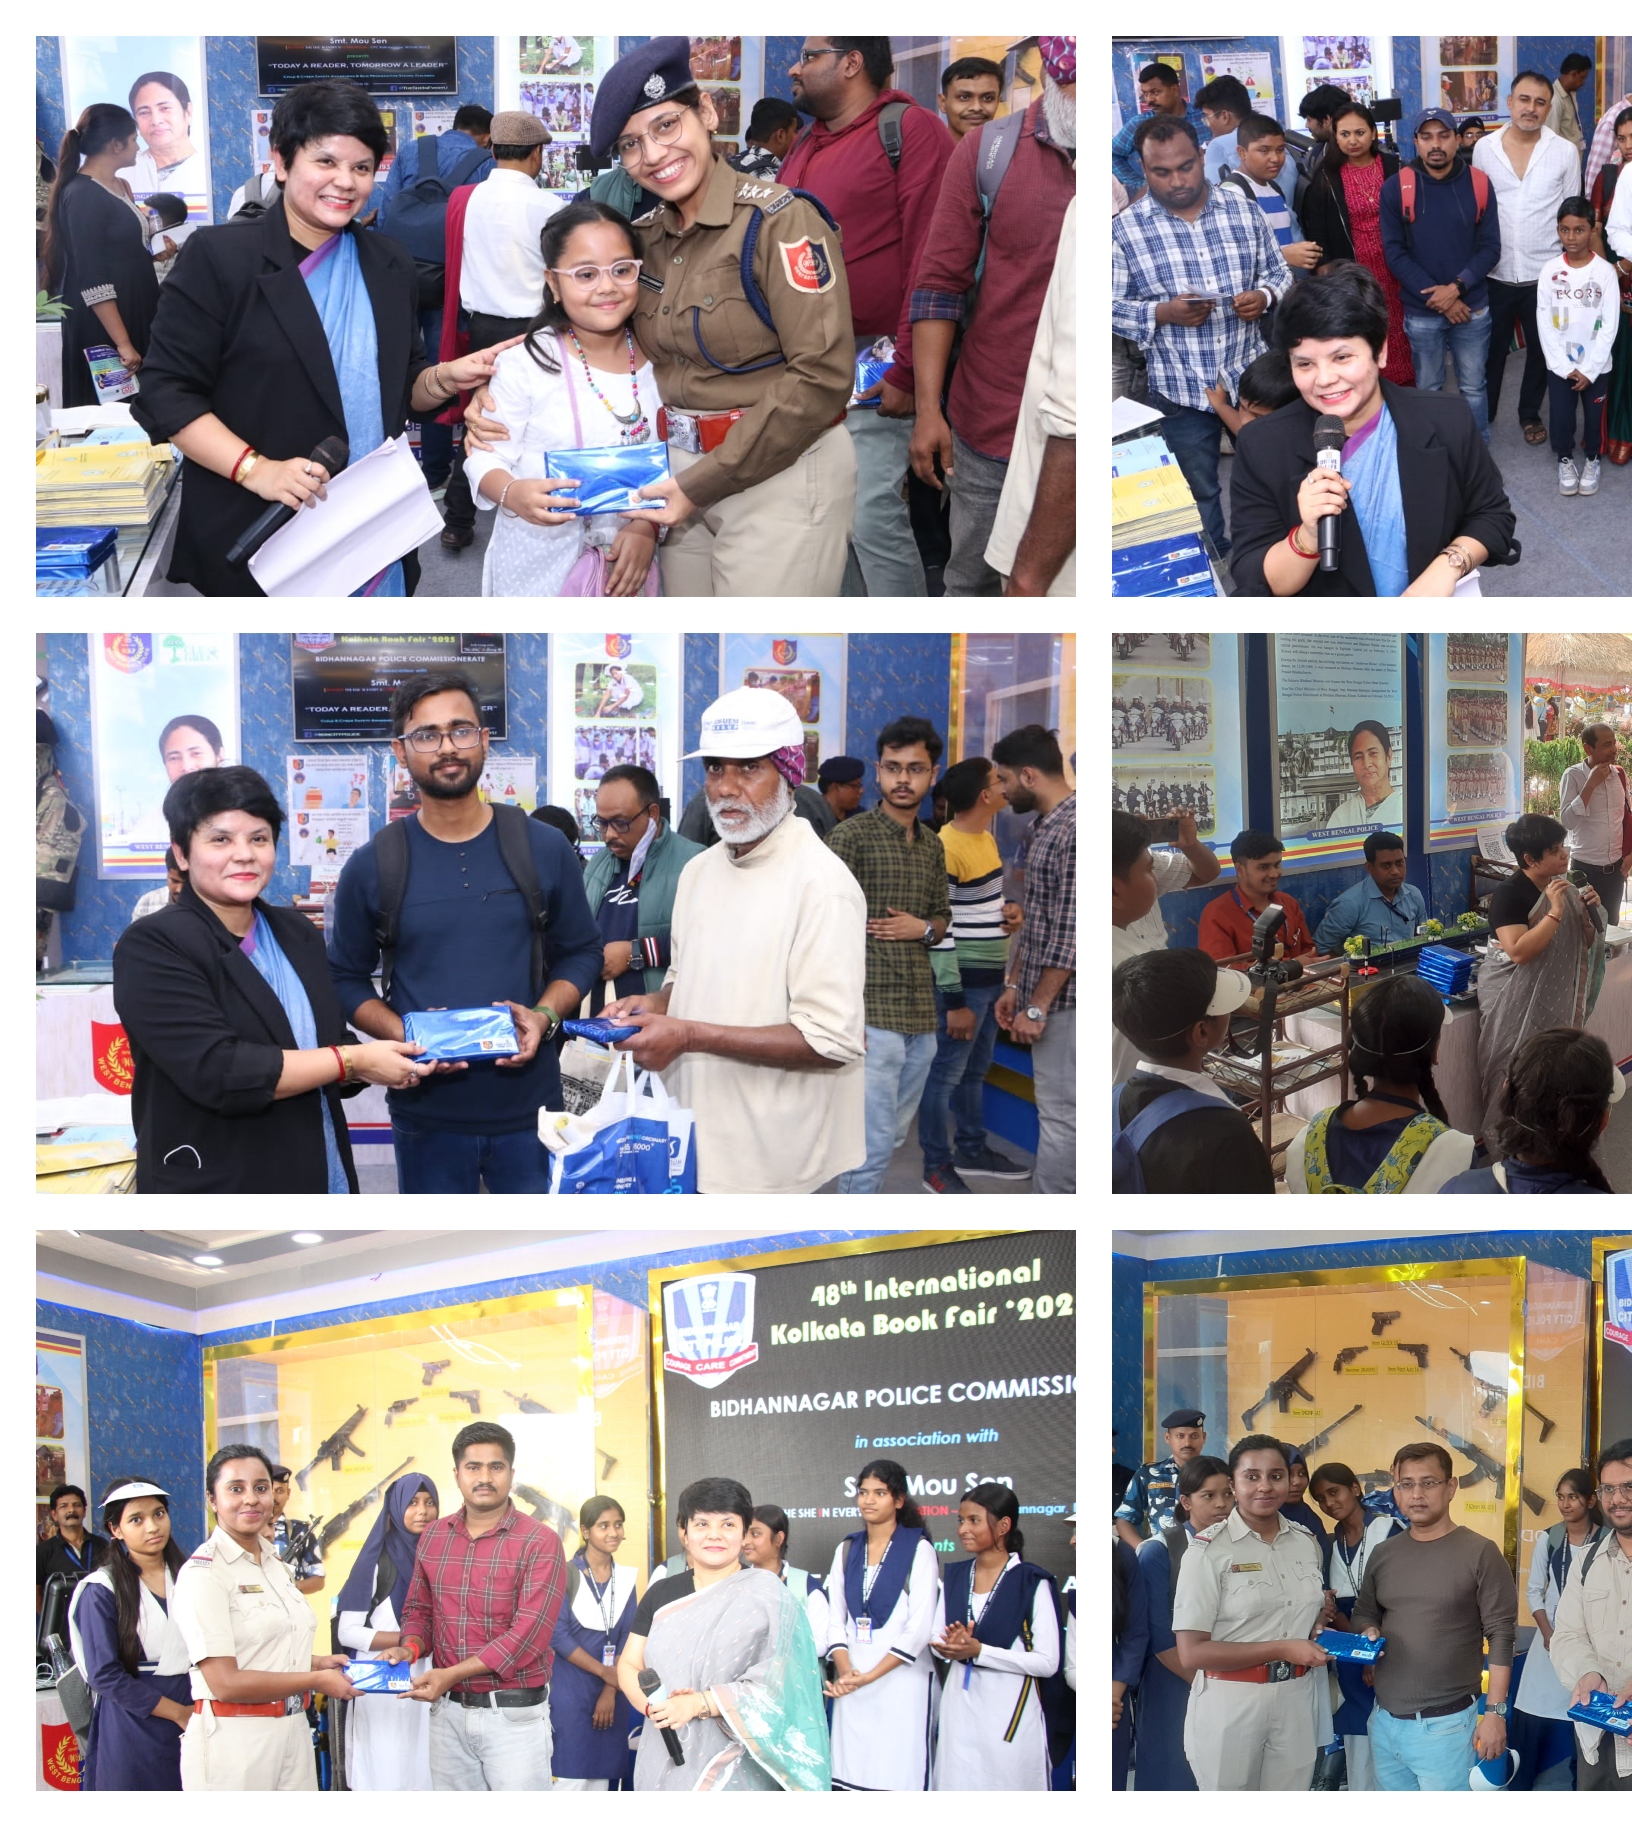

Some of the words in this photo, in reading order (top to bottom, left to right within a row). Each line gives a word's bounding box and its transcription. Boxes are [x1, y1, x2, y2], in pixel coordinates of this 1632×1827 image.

[315, 655, 377, 663] BIDHANNAGAR
[378, 655, 407, 663] POLICE
[409, 655, 486, 663] COMMISSIONERATE
[1311, 830, 1329, 839] WEST
[1330, 827, 1356, 837] BENGAL
[1357, 824, 1380, 834] POLICE
[864, 1257, 1041, 1302] International
[771, 1317, 866, 1346] Kolkata
[873, 1309, 938, 1336] Book
[945, 1302, 998, 1329] Fair
[1605, 1326, 1629, 1342] COURAGE
[666, 1358, 692, 1372] COURAGE
[695, 1361, 726, 1371] CARE
[710, 1391, 858, 1418] BIDHANNAGAR
[865, 1384, 941, 1408] POLICE
[854, 1434, 868, 1449] in
[872, 1431, 961, 1448] association
[967, 1428, 999, 1443] with
[905, 1475, 957, 1496] Mou
[798, 1507, 817, 1519] SHE
[47, 1757, 62, 1778] WEST
[60, 1775, 82, 1785] BENG
